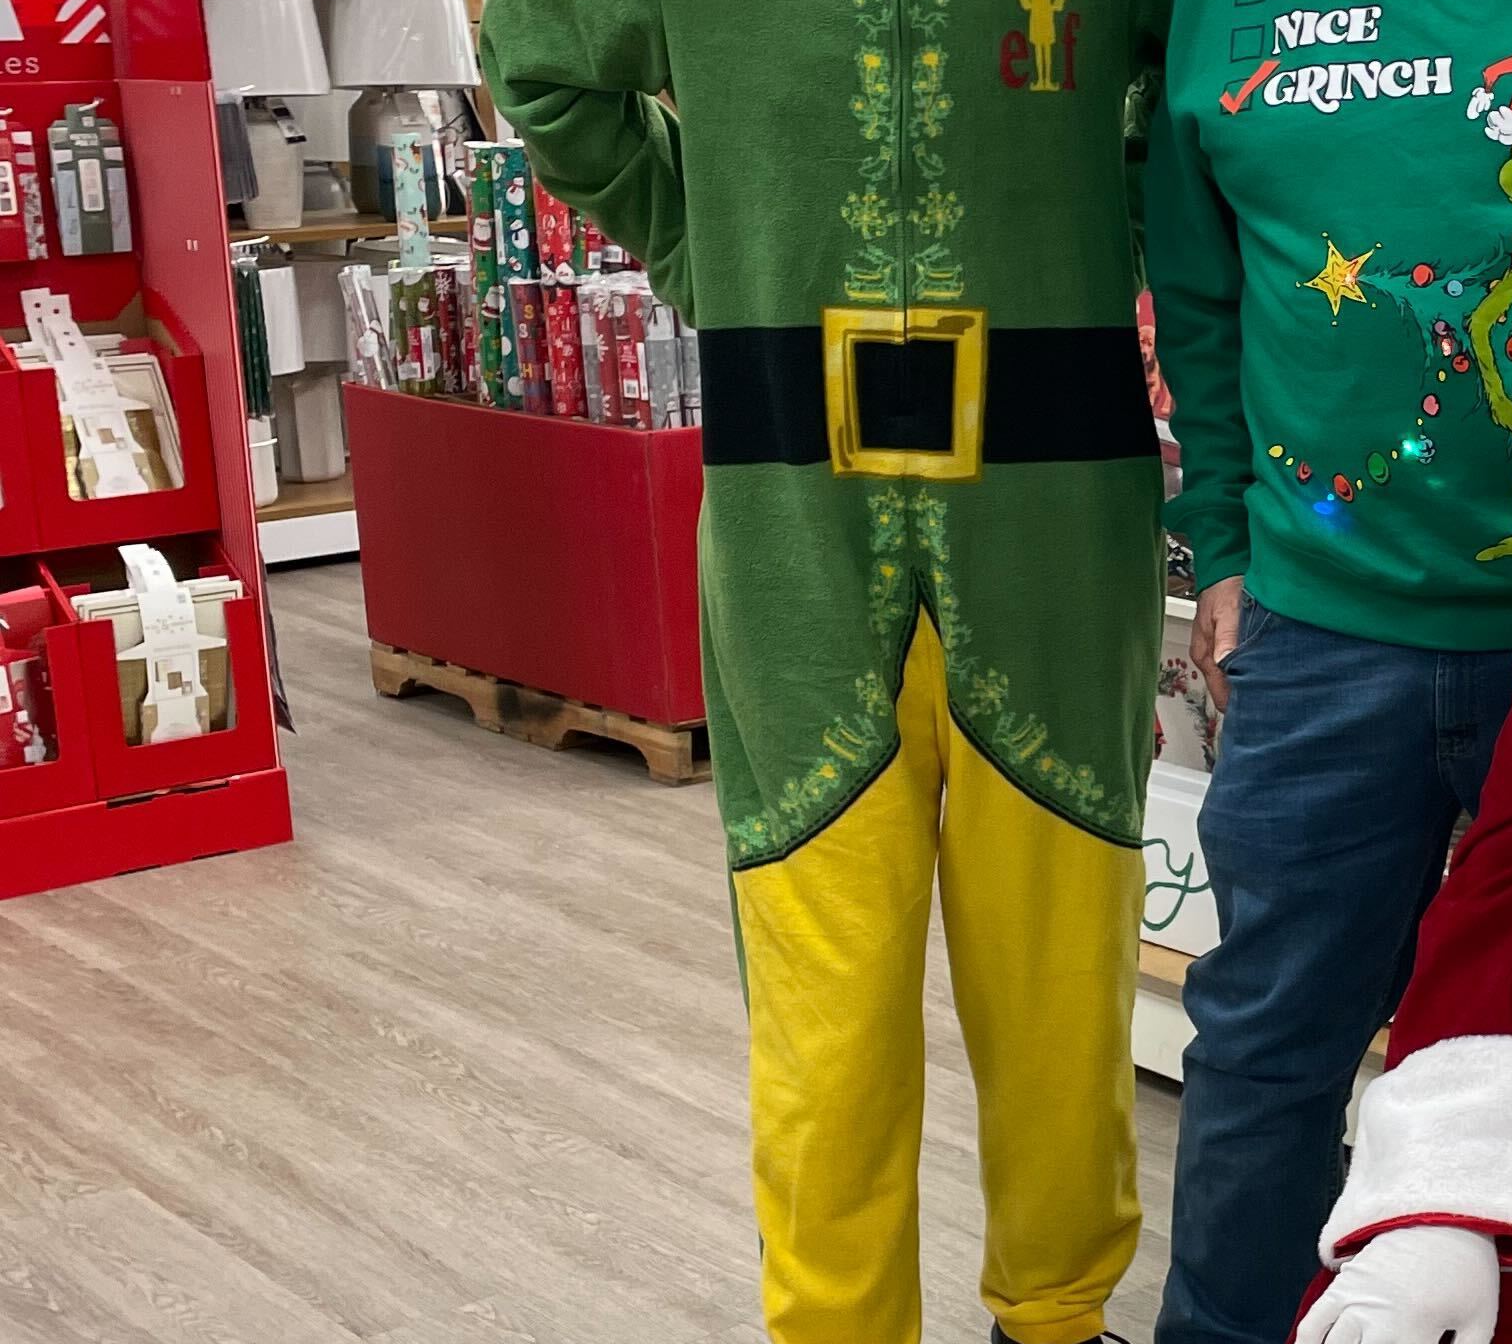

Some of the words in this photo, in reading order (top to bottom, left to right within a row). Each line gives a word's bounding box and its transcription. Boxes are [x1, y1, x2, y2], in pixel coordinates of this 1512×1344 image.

[1271, 5, 1383, 56] NICE
[0, 56, 40, 75] es
[1263, 56, 1453, 114] GRINCH
